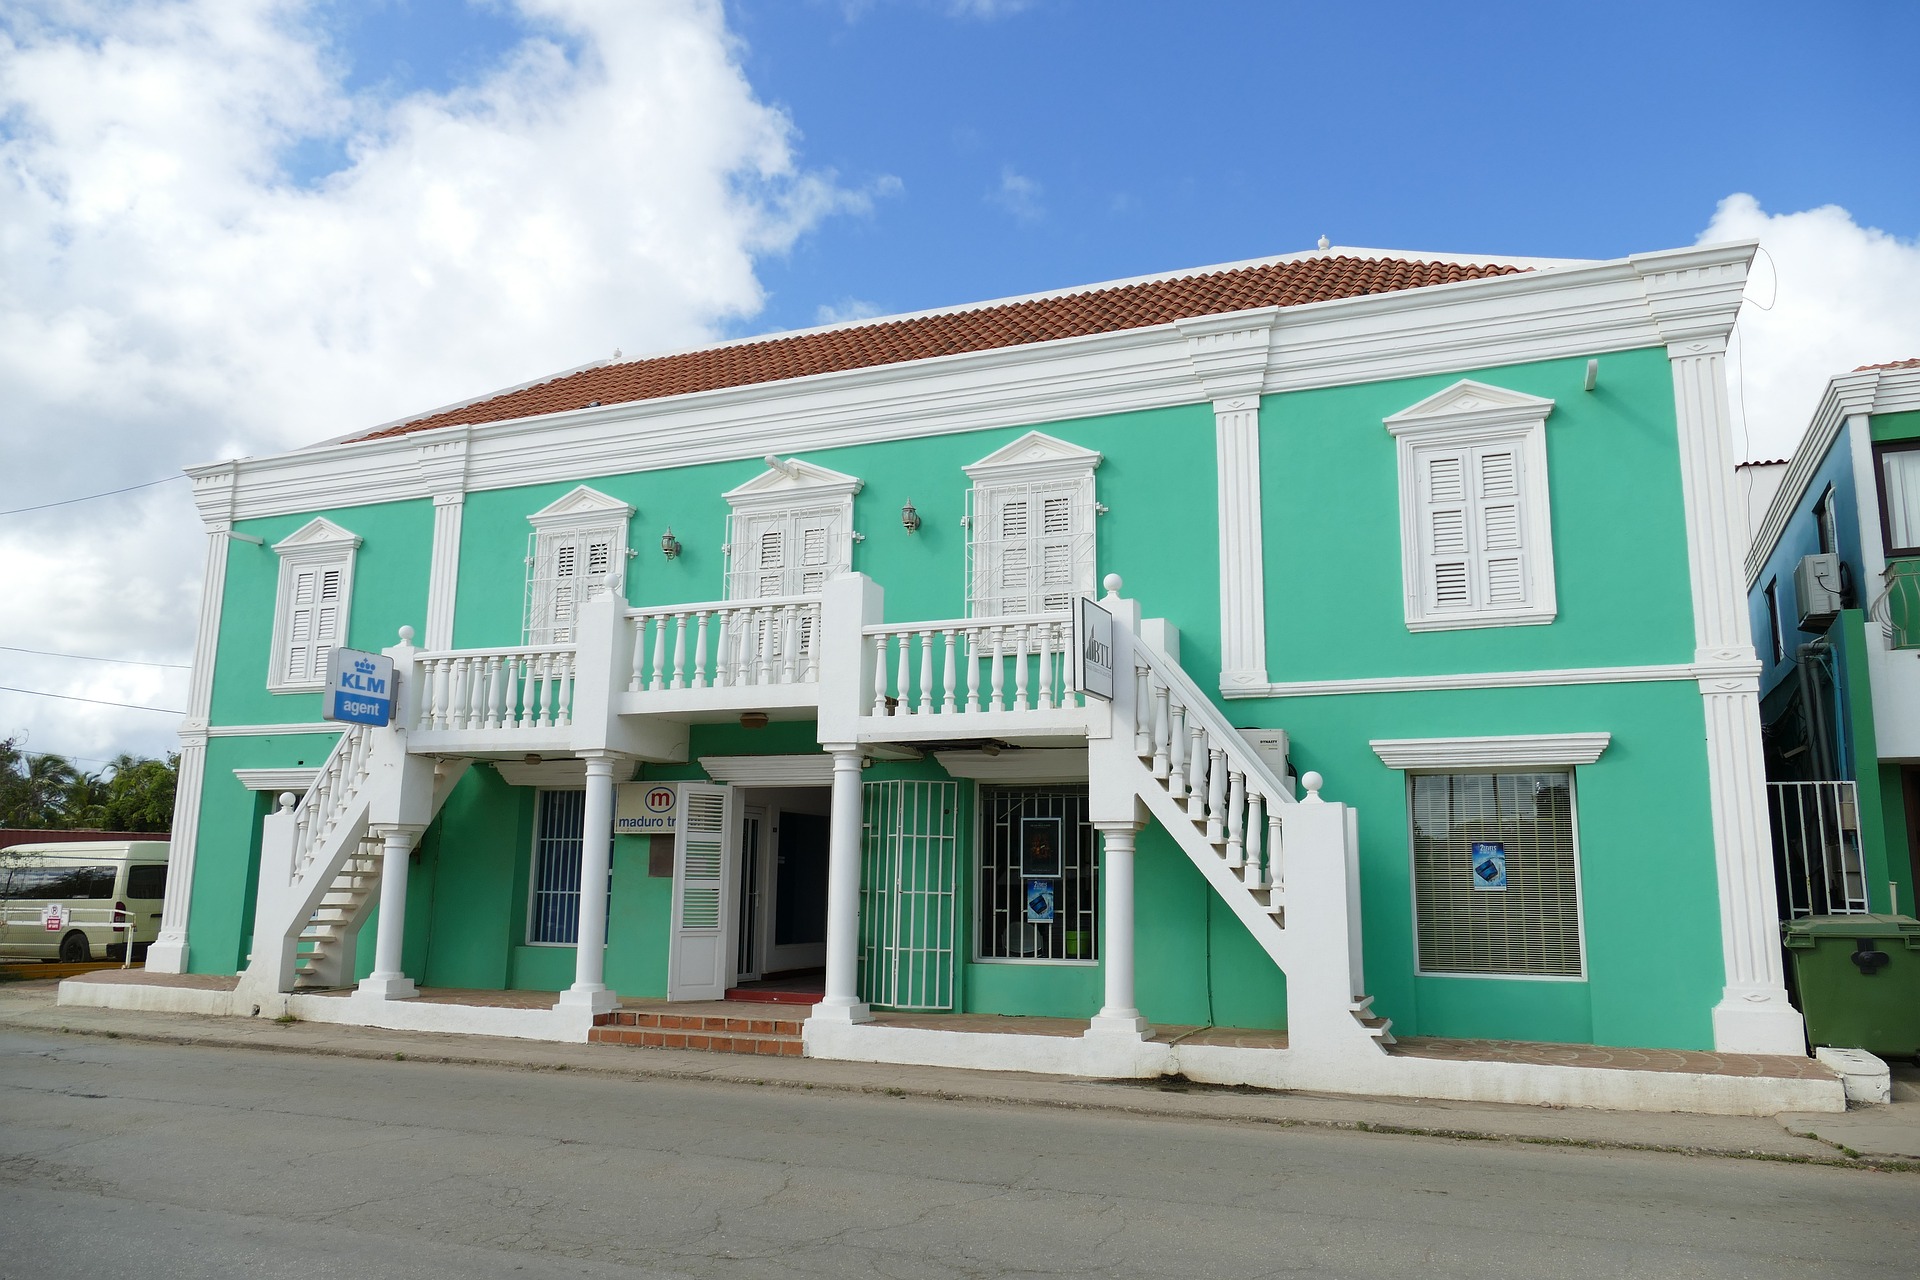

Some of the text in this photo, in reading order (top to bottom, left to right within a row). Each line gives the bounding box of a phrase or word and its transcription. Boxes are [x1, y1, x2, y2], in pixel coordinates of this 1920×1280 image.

[341, 671, 386, 694] KLM
[343, 700, 380, 716] agent
[651, 792, 670, 807] m
[618, 815, 664, 828] maduro
